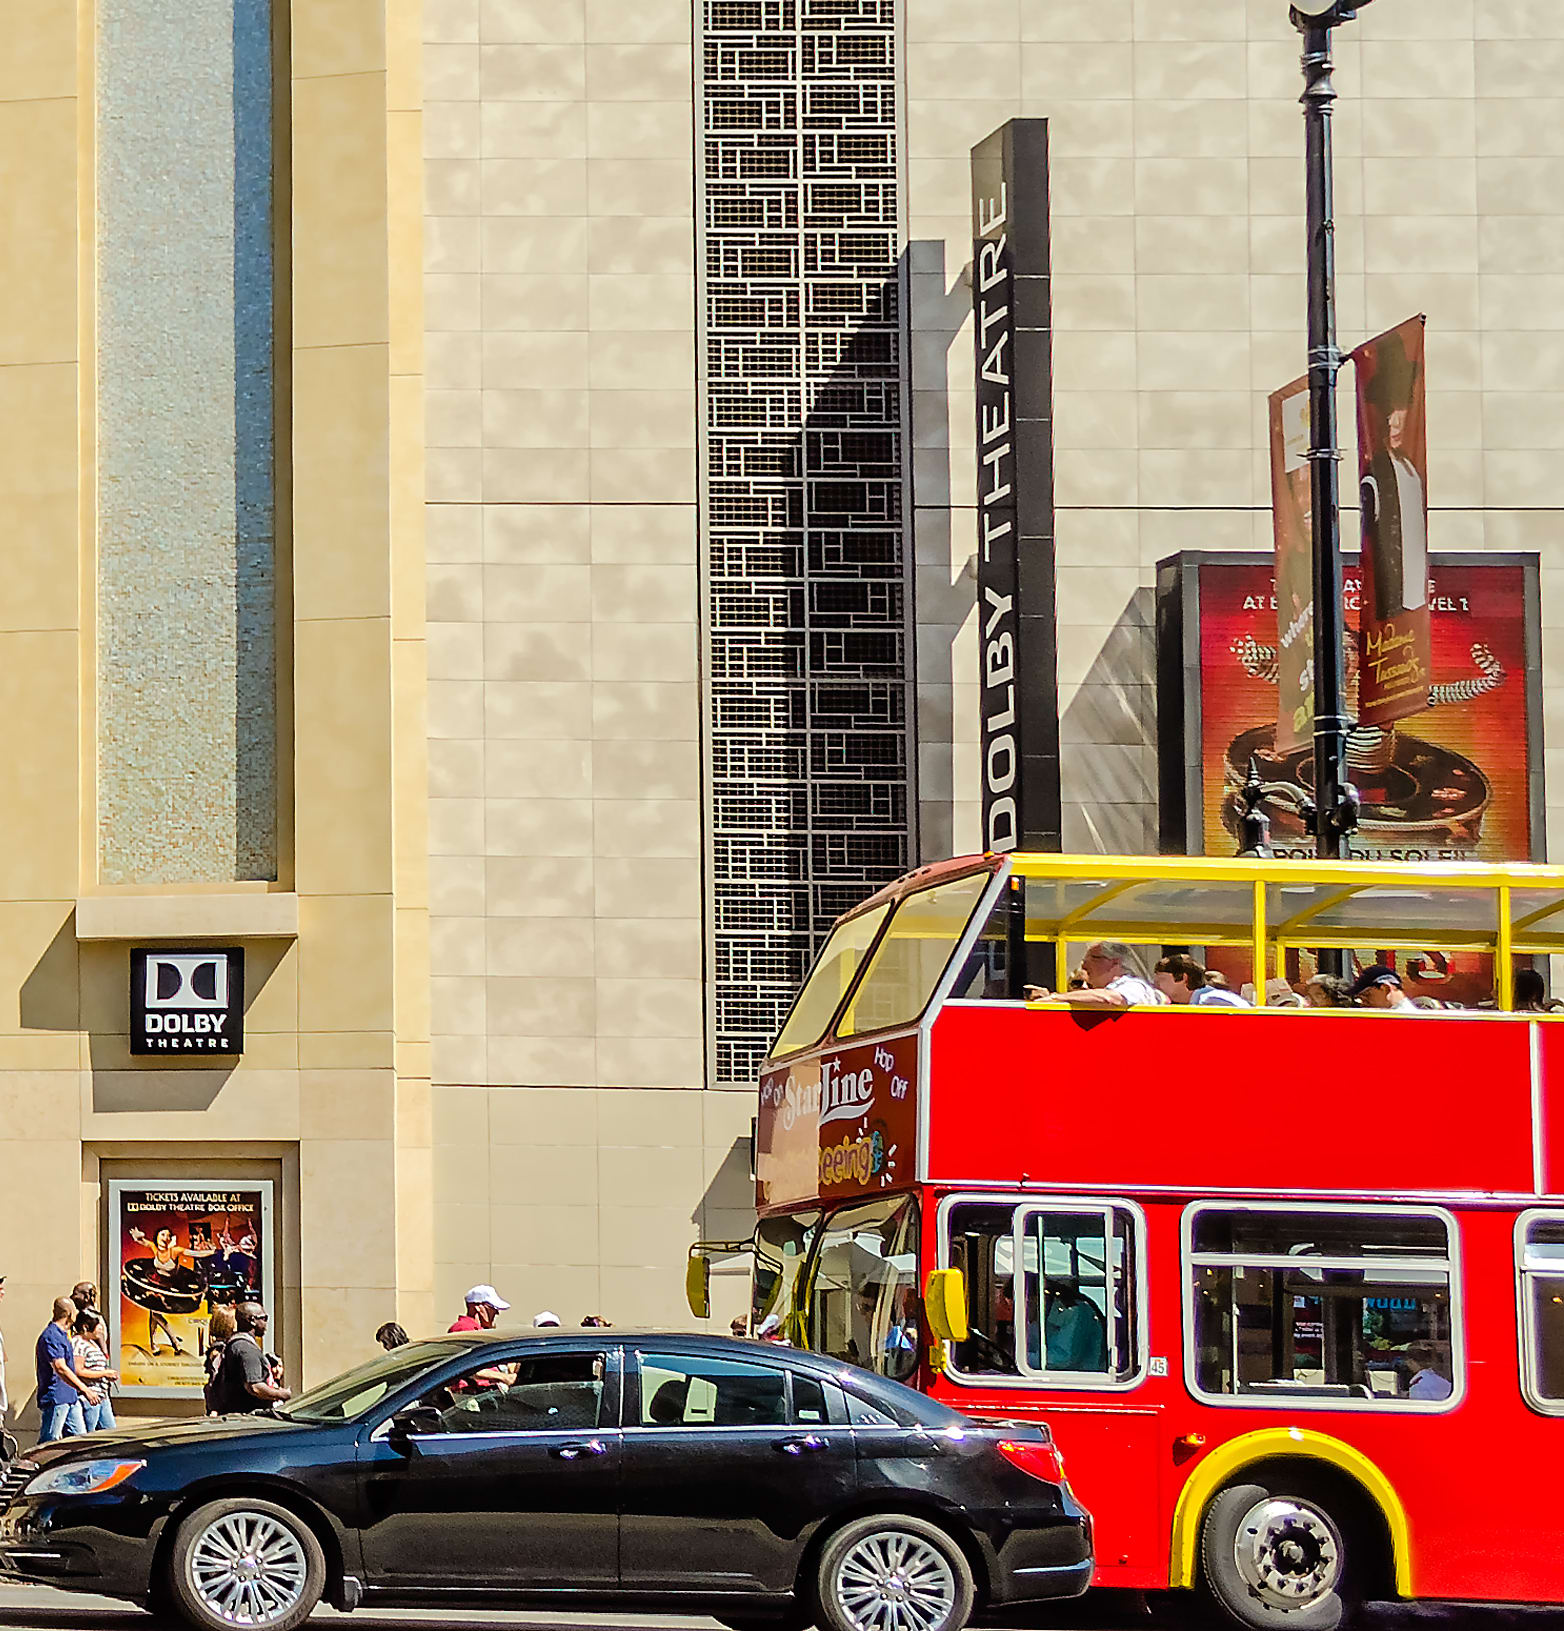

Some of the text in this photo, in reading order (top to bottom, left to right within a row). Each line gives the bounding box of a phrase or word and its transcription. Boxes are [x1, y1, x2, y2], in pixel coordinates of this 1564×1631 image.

[979, 182, 1018, 853] DOLBY THEATRE
[145, 1013, 227, 1033] DOLBY
[146, 1038, 229, 1048] THEATRE
[145, 1192, 241, 1202] TICKETS AVAILABLE AT
[169, 1203, 205, 1212] THEATRE
[227, 1203, 254, 1212] OFFICE
[1151, 1360, 1165, 1374] 45
